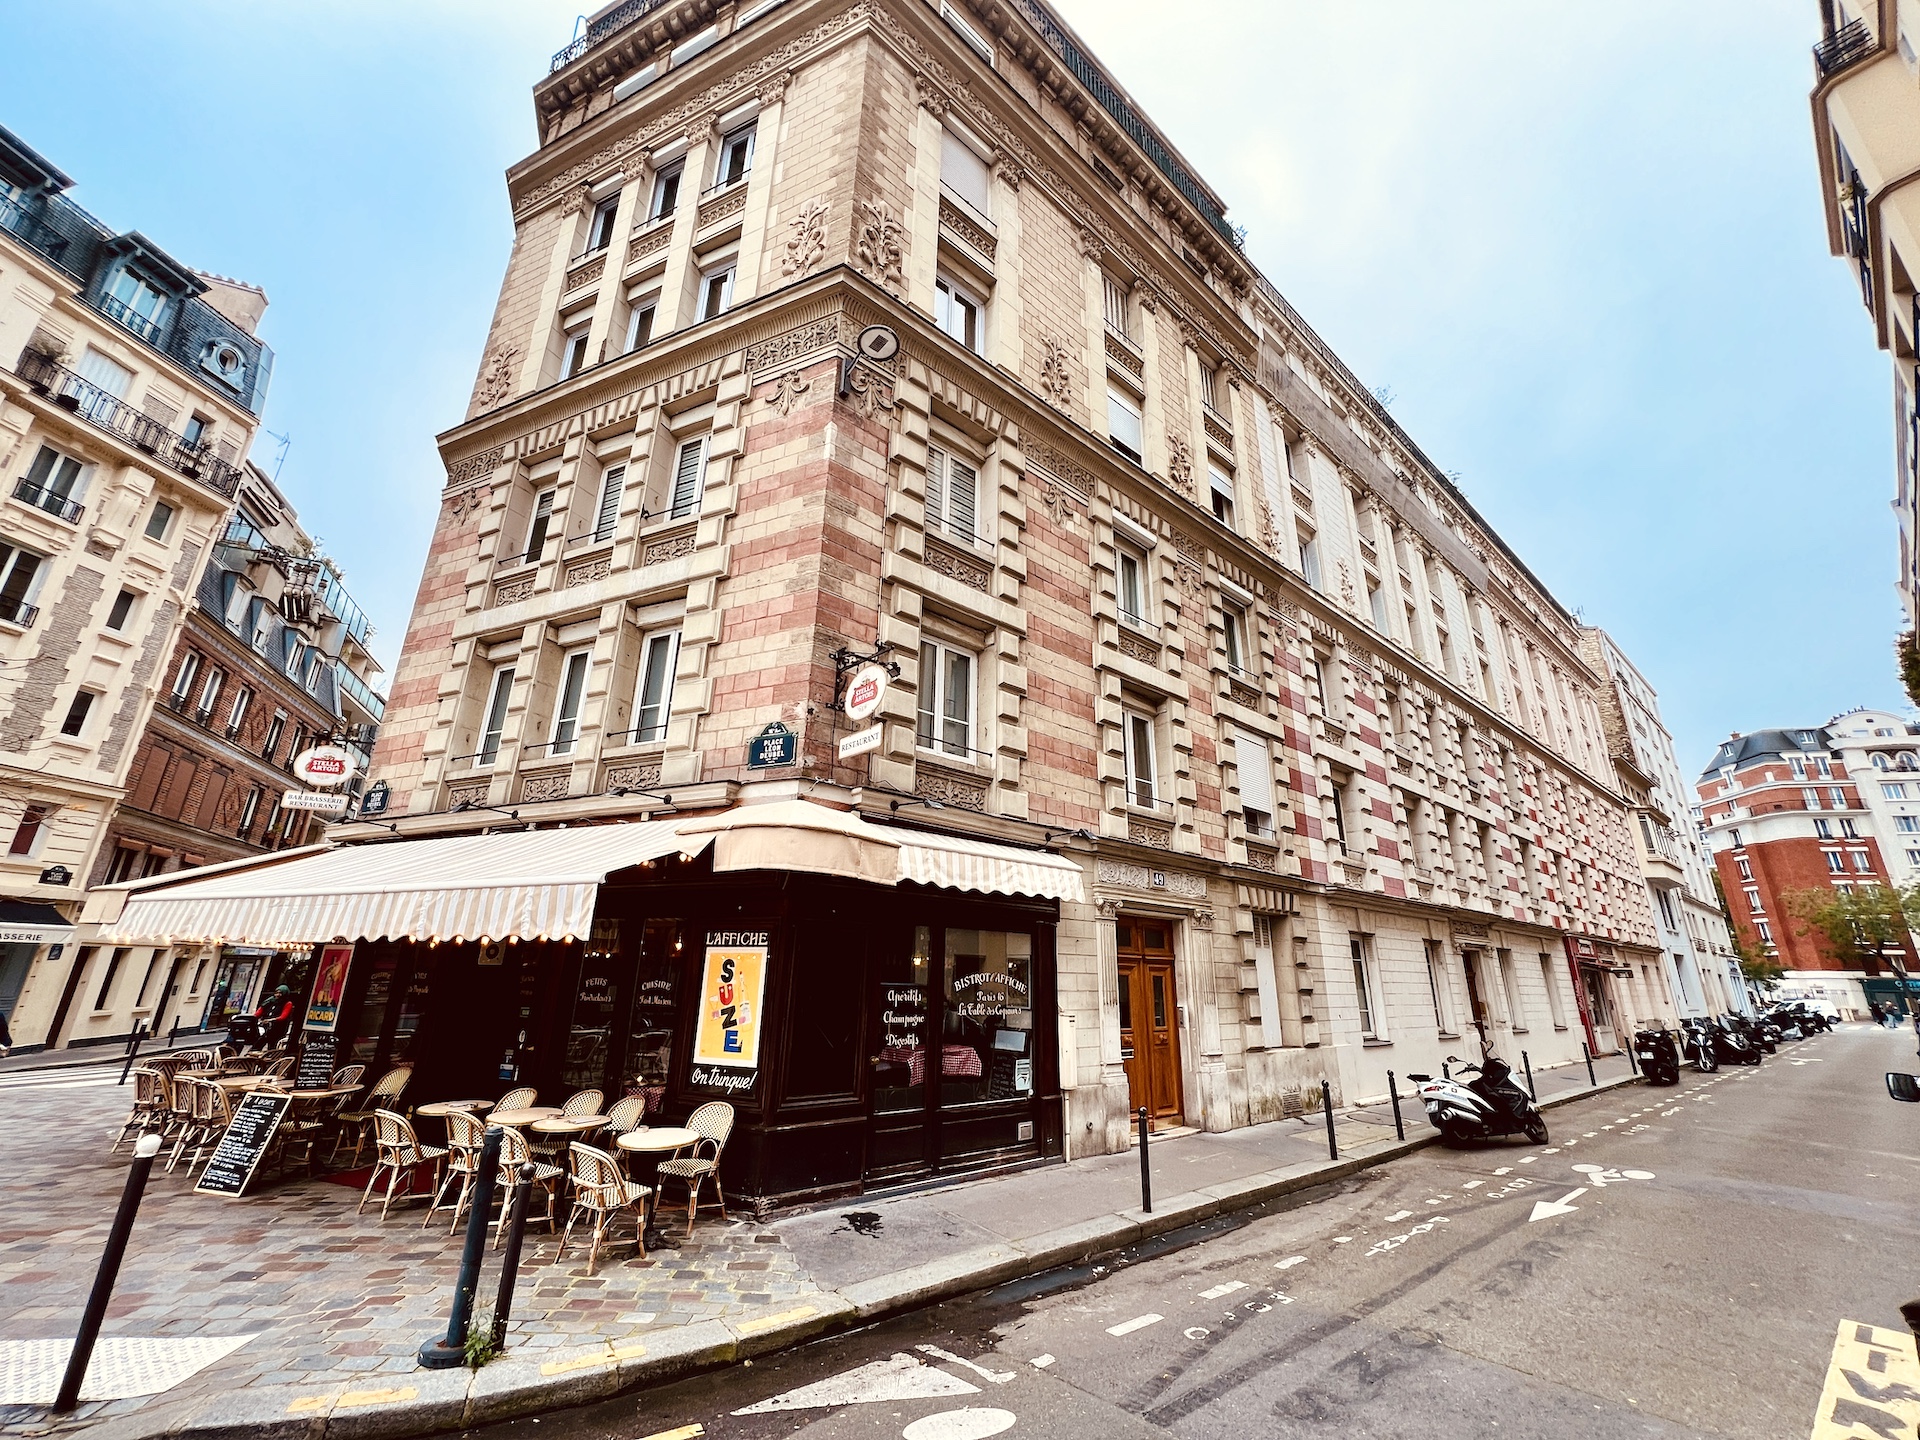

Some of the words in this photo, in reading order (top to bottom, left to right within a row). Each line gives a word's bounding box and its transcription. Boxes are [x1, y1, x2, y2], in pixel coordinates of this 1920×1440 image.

[854, 690, 875, 703] ARTOIS
[855, 683, 875, 697] STELLA
[763, 738, 784, 746] PLACE
[841, 732, 880, 752] RESTAURANT
[759, 751, 785, 760] DEUBEL
[288, 800, 339, 810] RESTAURANT
[304, 796, 344, 804] BRASSERIE
[706, 932, 769, 946] L'AFFICHE
[641, 979, 672, 991] CUISINE
[953, 972, 992, 993] BISTROT
[976, 990, 997, 1002] Paris
[997, 991, 1005, 1002] 16
[718, 958, 743, 1054] SUZE
[957, 1002, 967, 1016] La
[966, 1002, 986, 1016] Table
[307, 1009, 335, 1022] RICARD
[883, 1010, 925, 1028] Champagne
[885, 1033, 919, 1050] Digestifs
[691, 1067, 708, 1085] On
